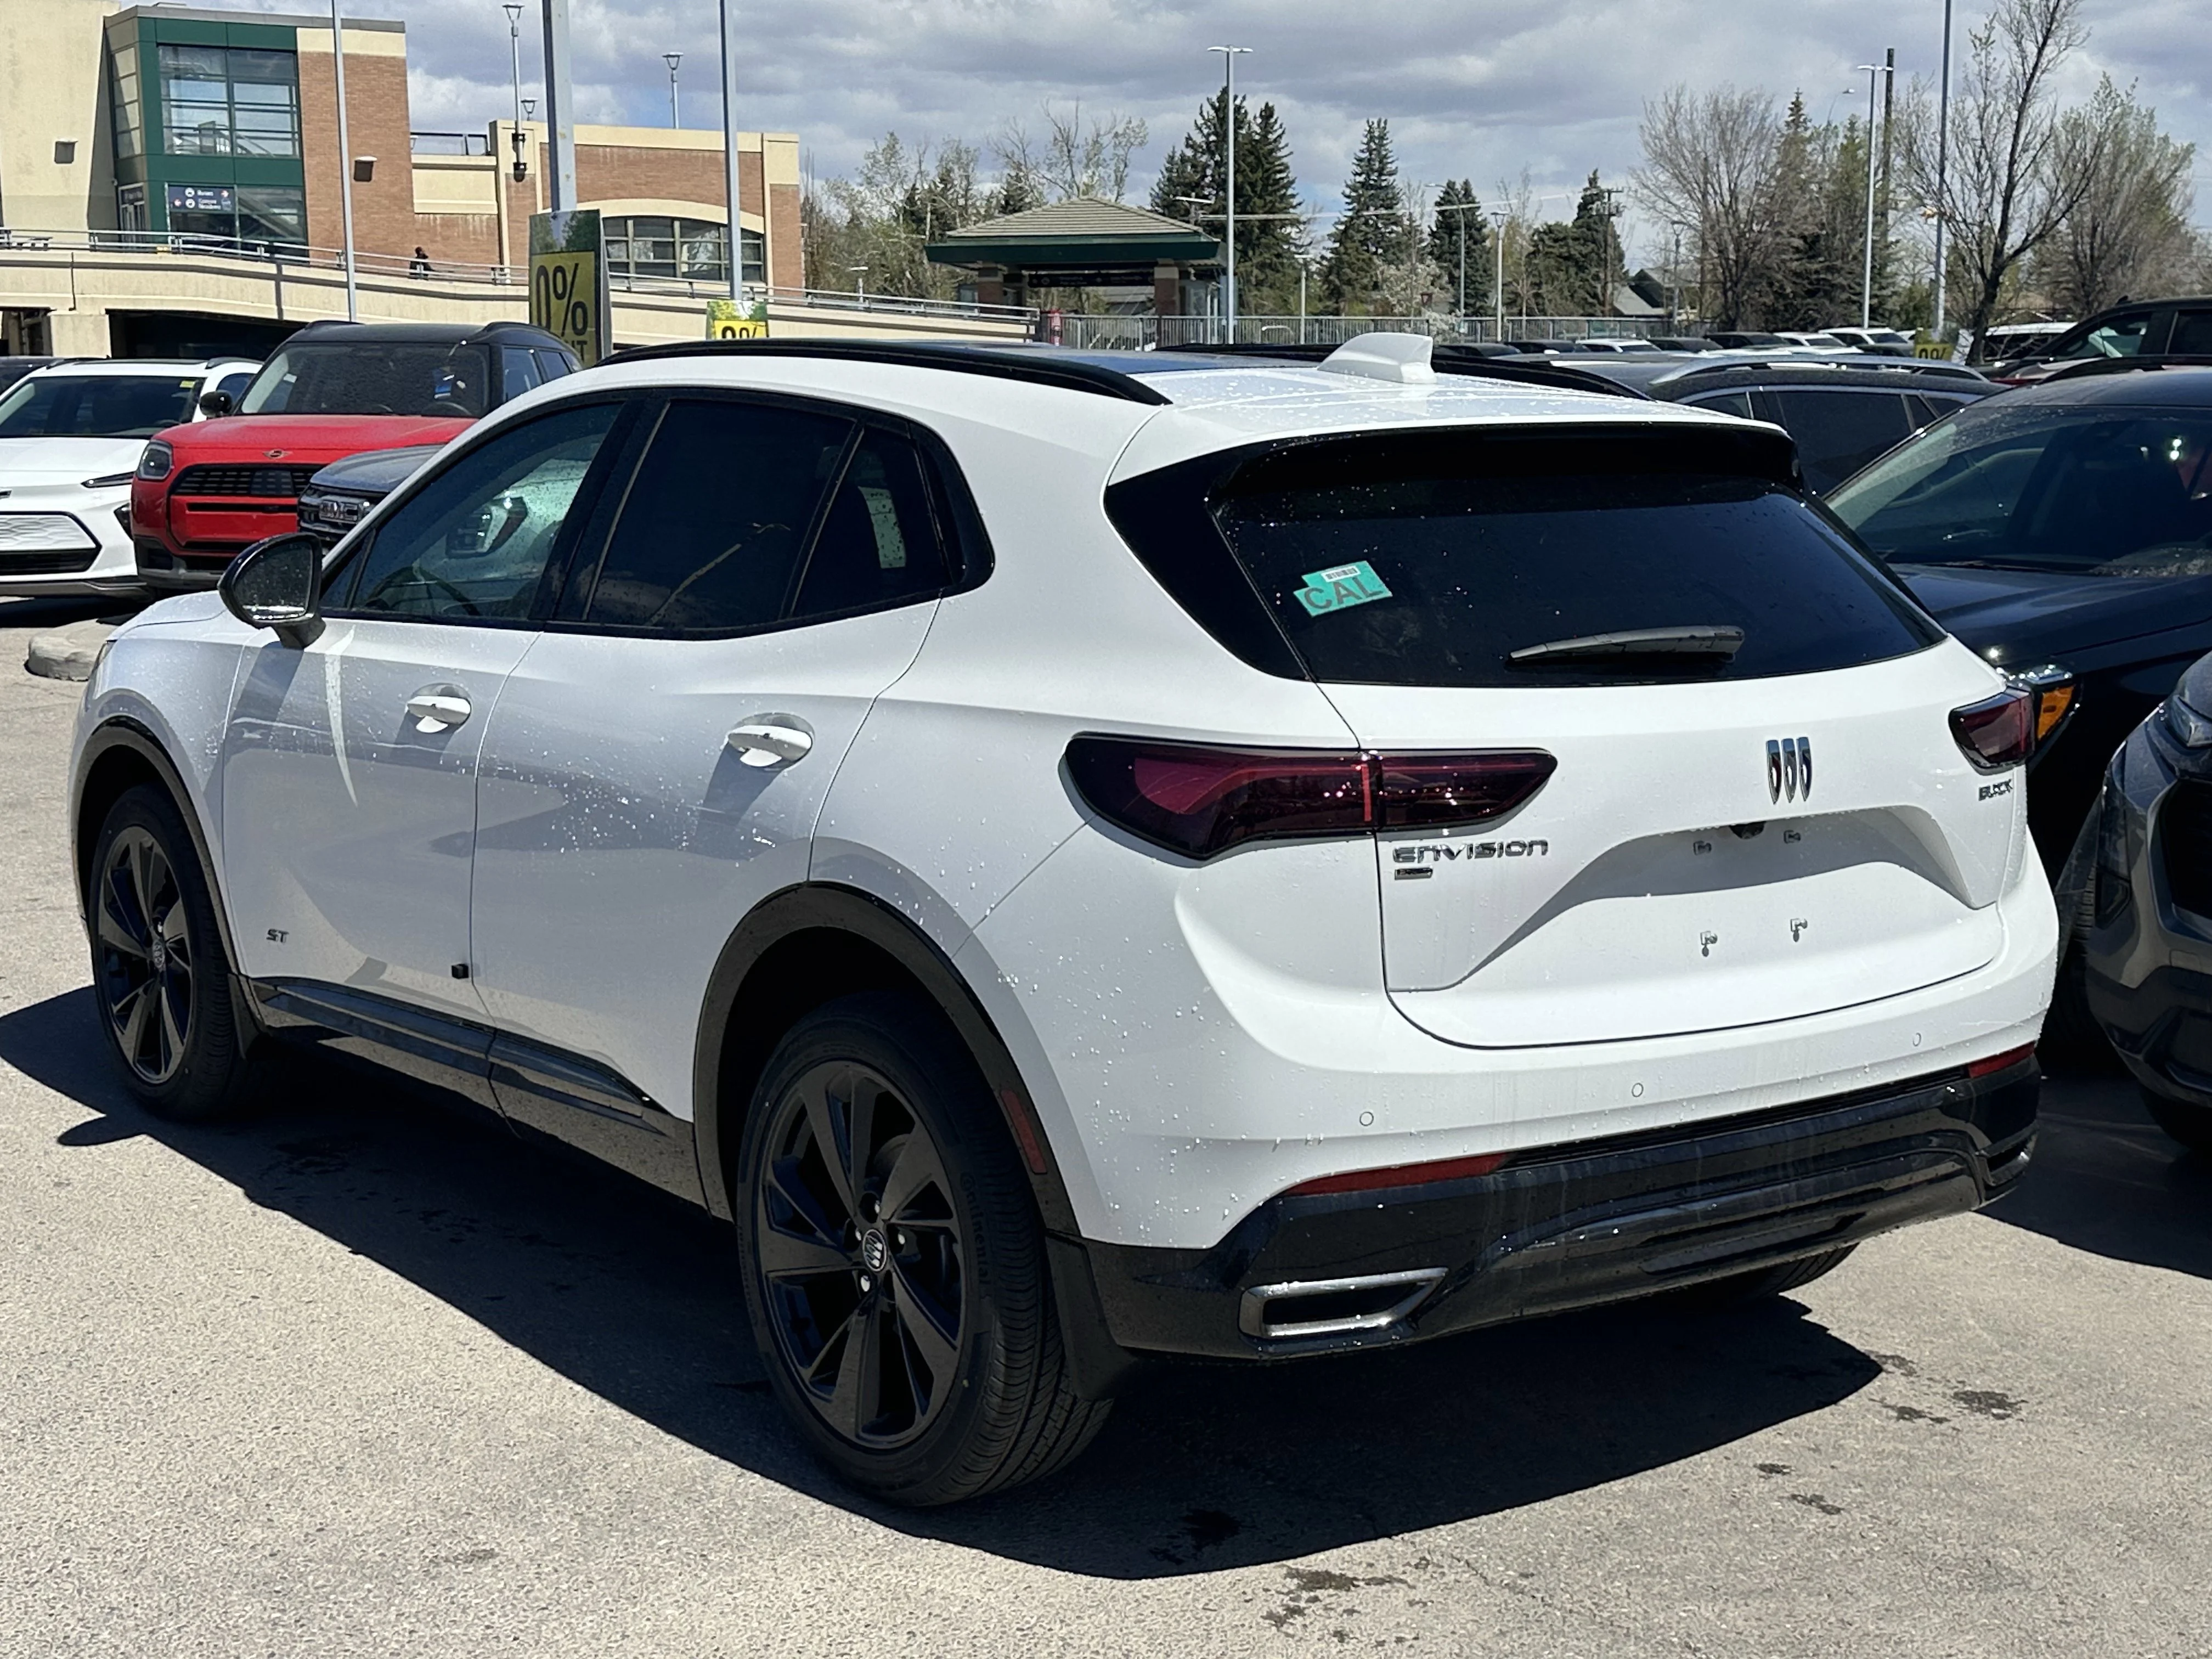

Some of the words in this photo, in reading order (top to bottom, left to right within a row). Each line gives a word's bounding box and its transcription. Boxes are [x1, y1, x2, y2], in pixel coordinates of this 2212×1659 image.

[536, 263, 588, 336] 0%
[1304, 577, 1384, 609] CAL
[1979, 779, 2013, 801] BUICK
[266, 929, 290, 943] ST
[961, 1172, 991, 1285] Continental
